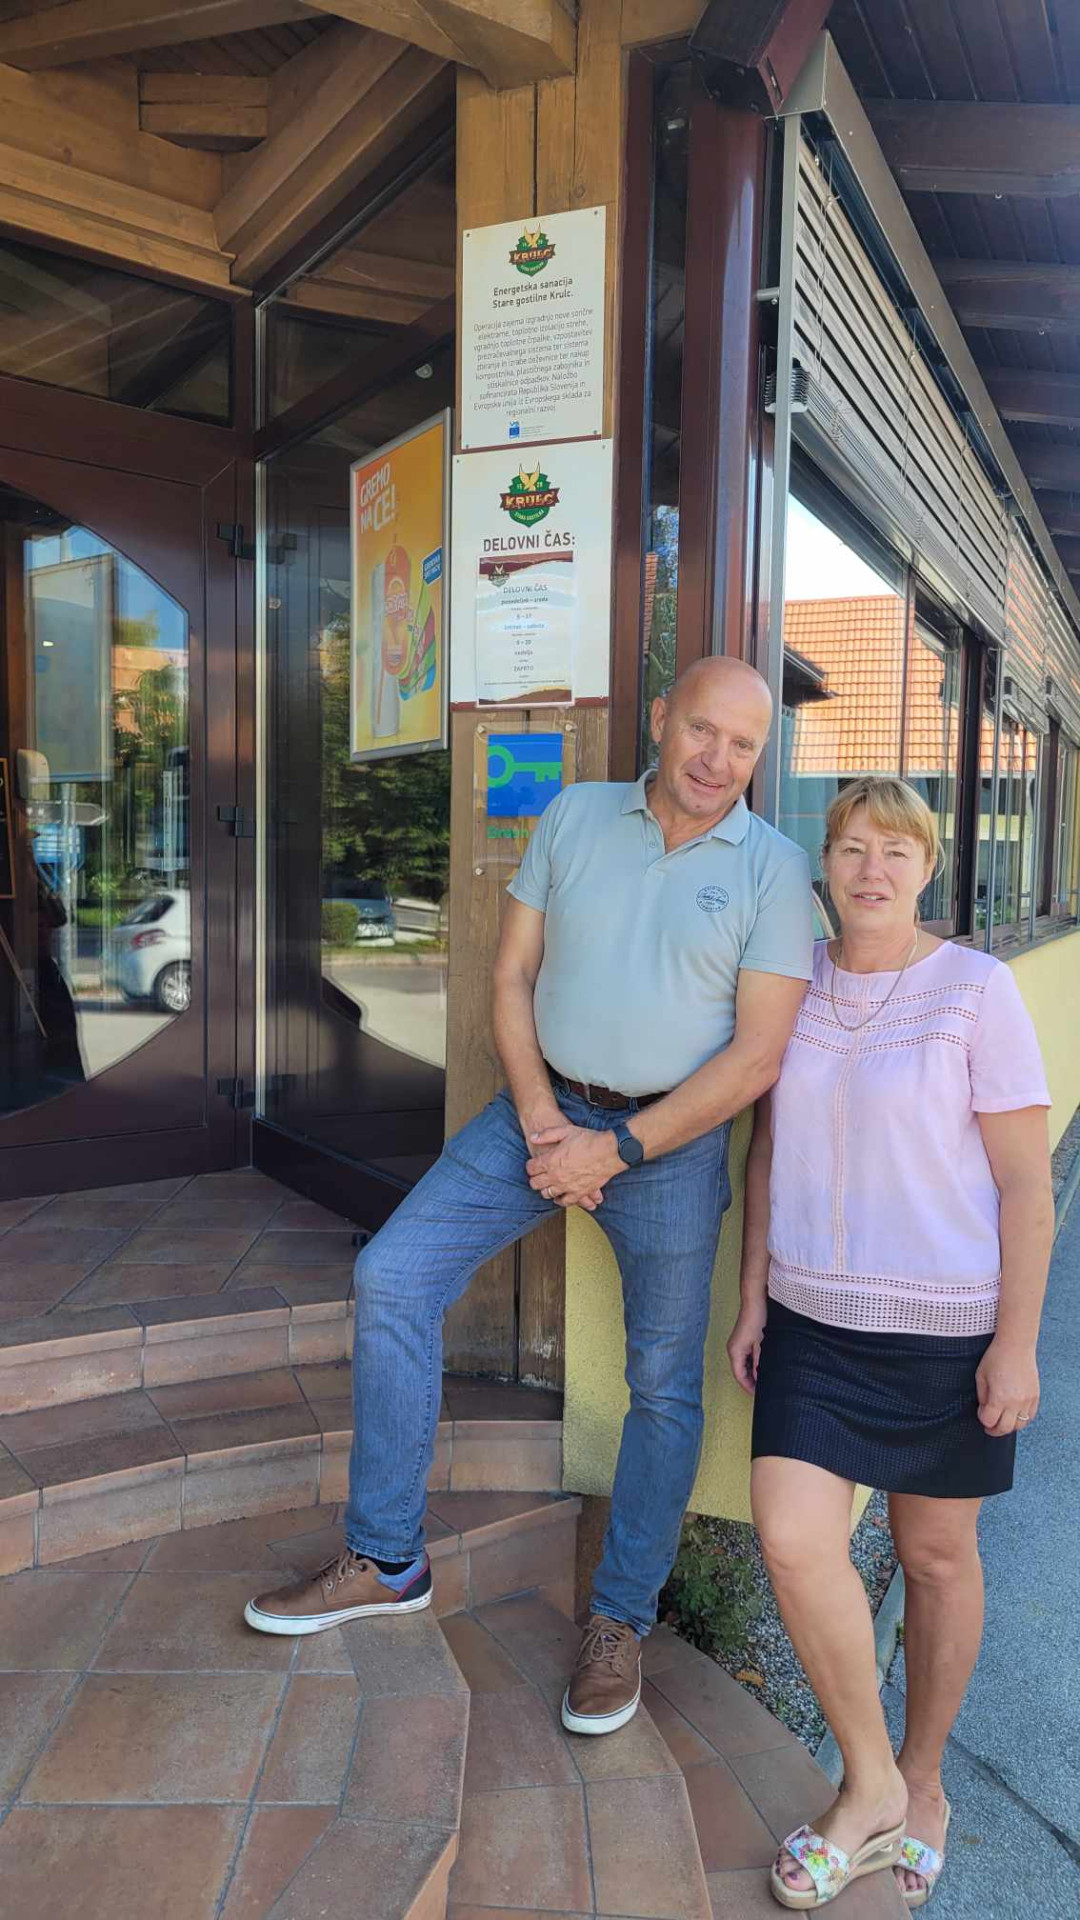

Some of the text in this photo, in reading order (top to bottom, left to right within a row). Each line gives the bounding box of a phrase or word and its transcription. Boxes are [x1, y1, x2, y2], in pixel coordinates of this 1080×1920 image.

[493, 276, 573, 296] Energetska sanacija
[492, 289, 574, 309] Stare gostilne Krulc.
[473, 321, 502, 333] Operacija
[555, 311, 570, 320] nove
[553, 343, 563, 351] ter
[563, 340, 589, 350] sistema
[360, 462, 391, 508] GREMO
[506, 493, 554, 506] KRULC
[483, 529, 576, 552] DELOVNI ČAS:
[503, 583, 548, 594] DELOVNI ČAS
